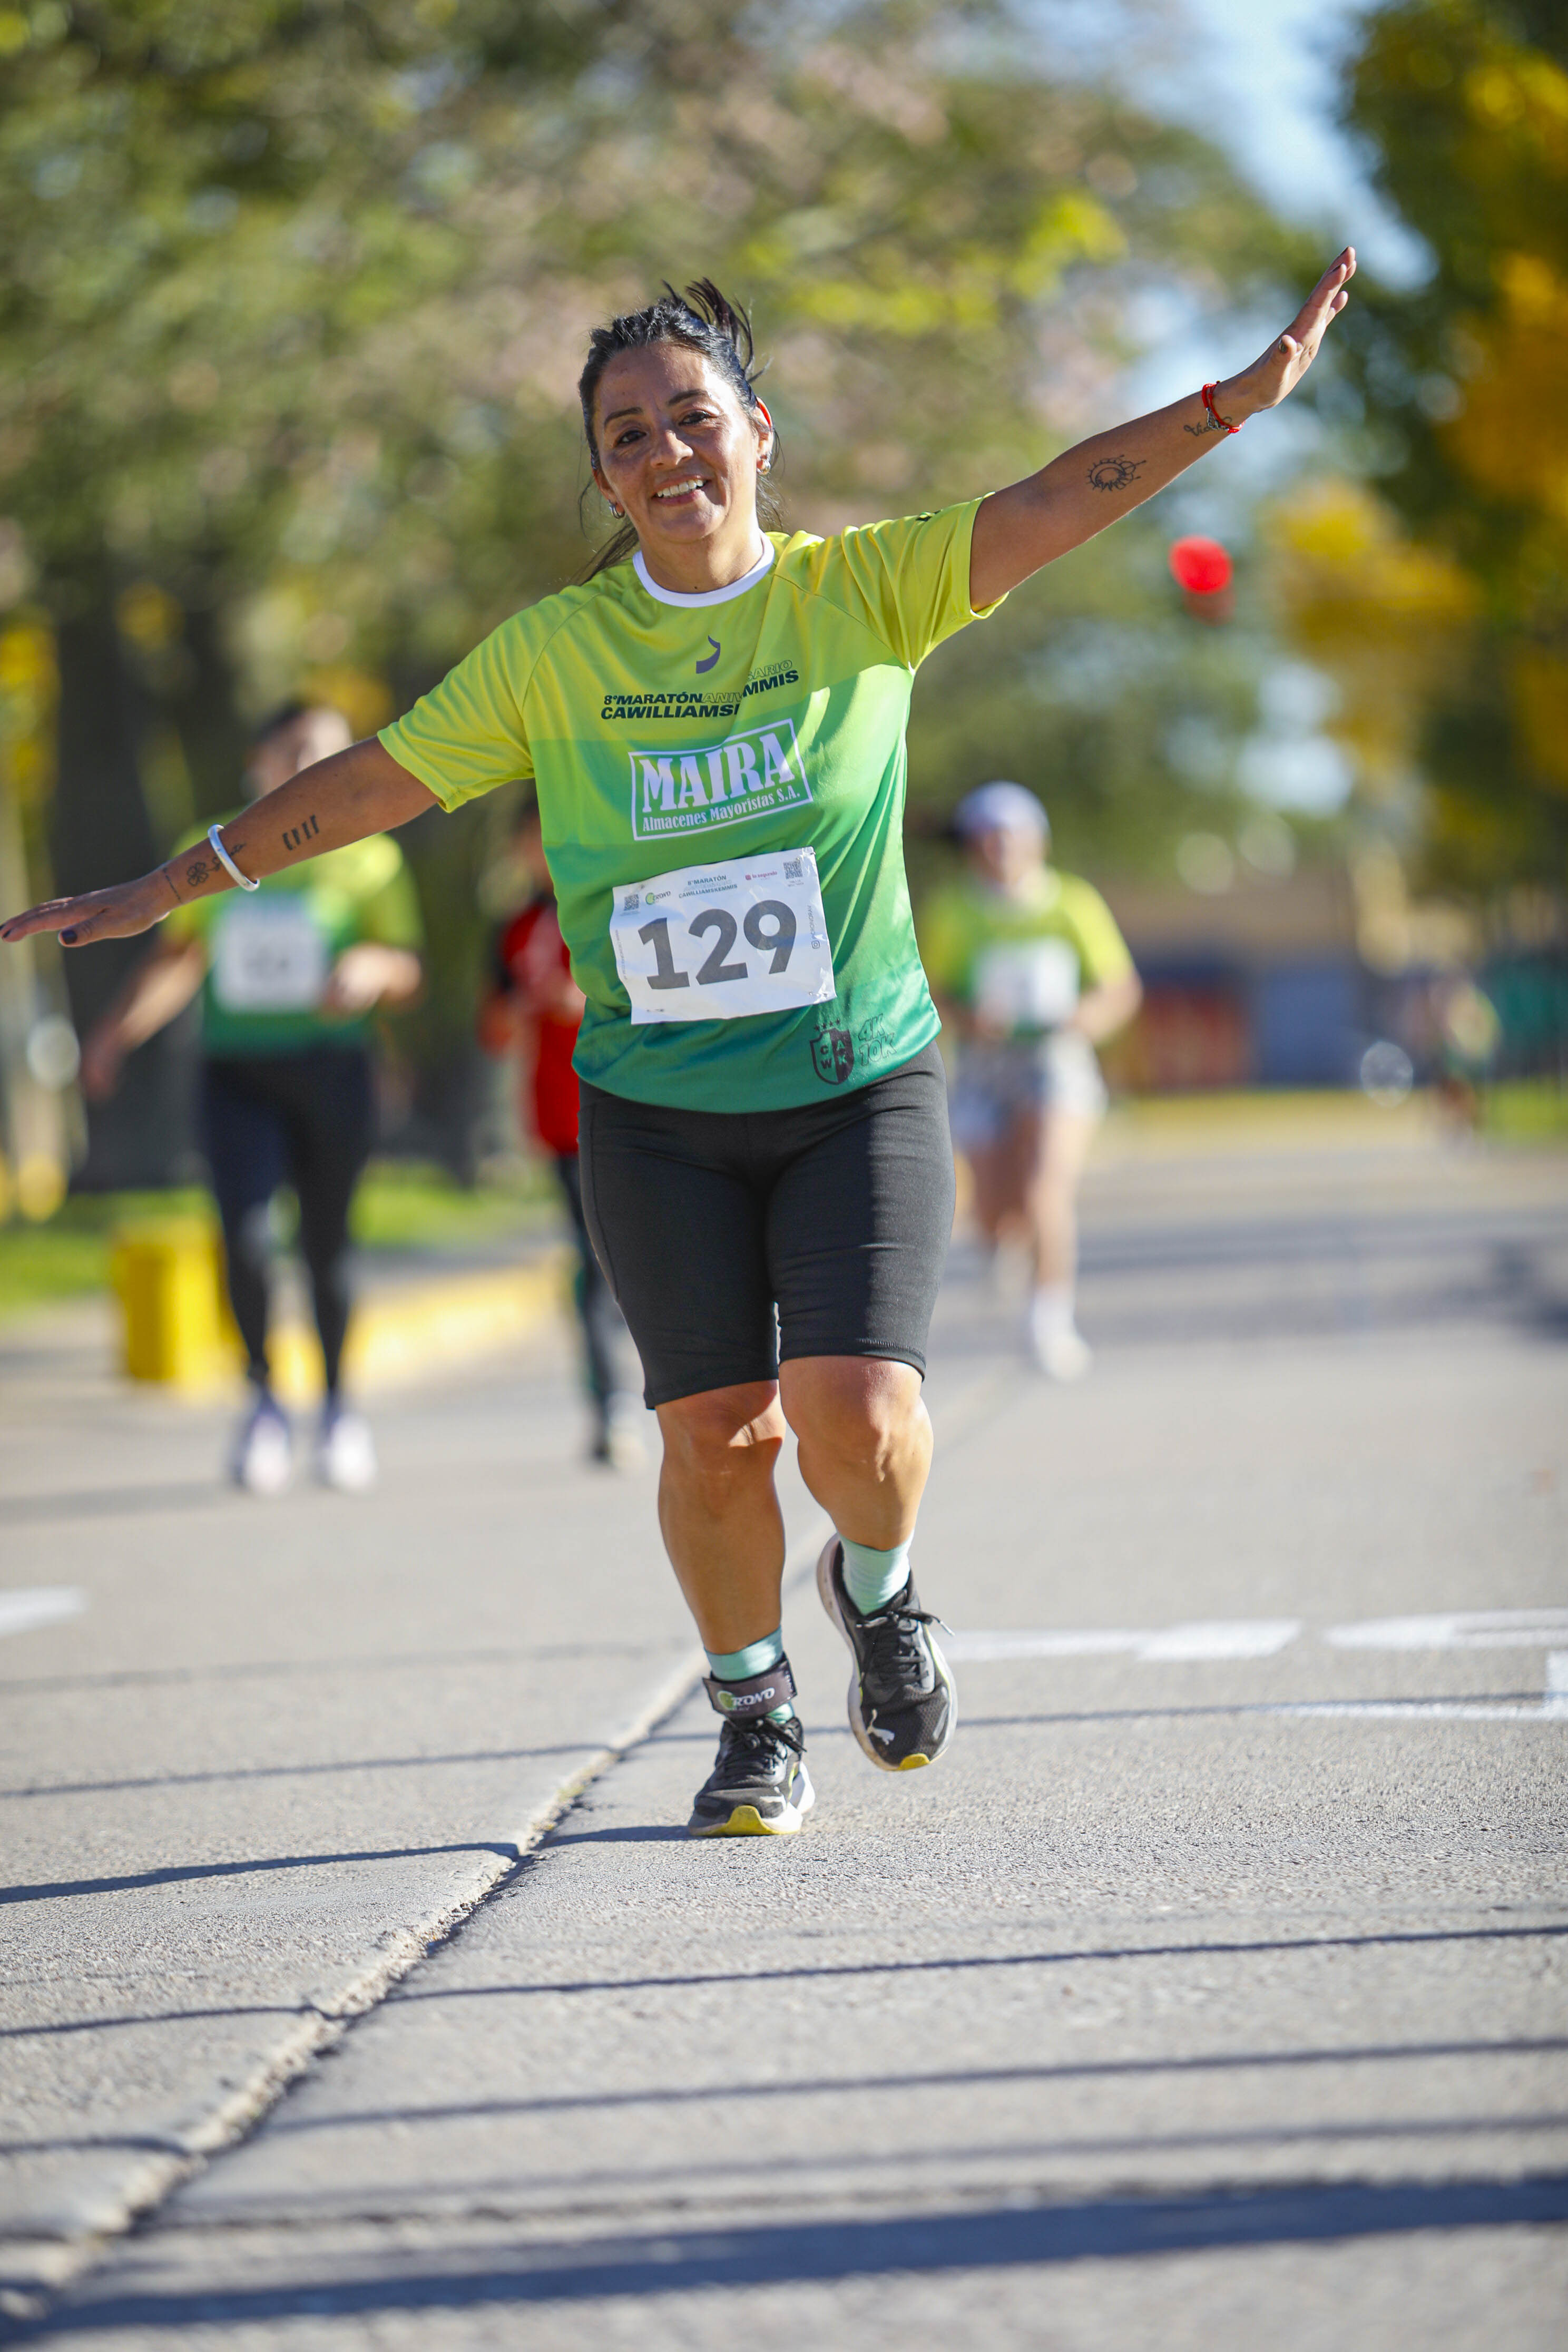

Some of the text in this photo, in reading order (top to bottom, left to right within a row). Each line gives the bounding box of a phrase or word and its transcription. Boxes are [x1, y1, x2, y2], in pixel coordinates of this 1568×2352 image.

[639, 732, 795, 813] MAIRA
[642, 785, 800, 832] Almacenes Mayoristas S.A.
[679, 884, 738, 898] CAWILLIAMSKEMMIS
[638, 899, 797, 989] 129
[858, 1013, 885, 1042] 4K
[859, 1033, 897, 1067] 10K
